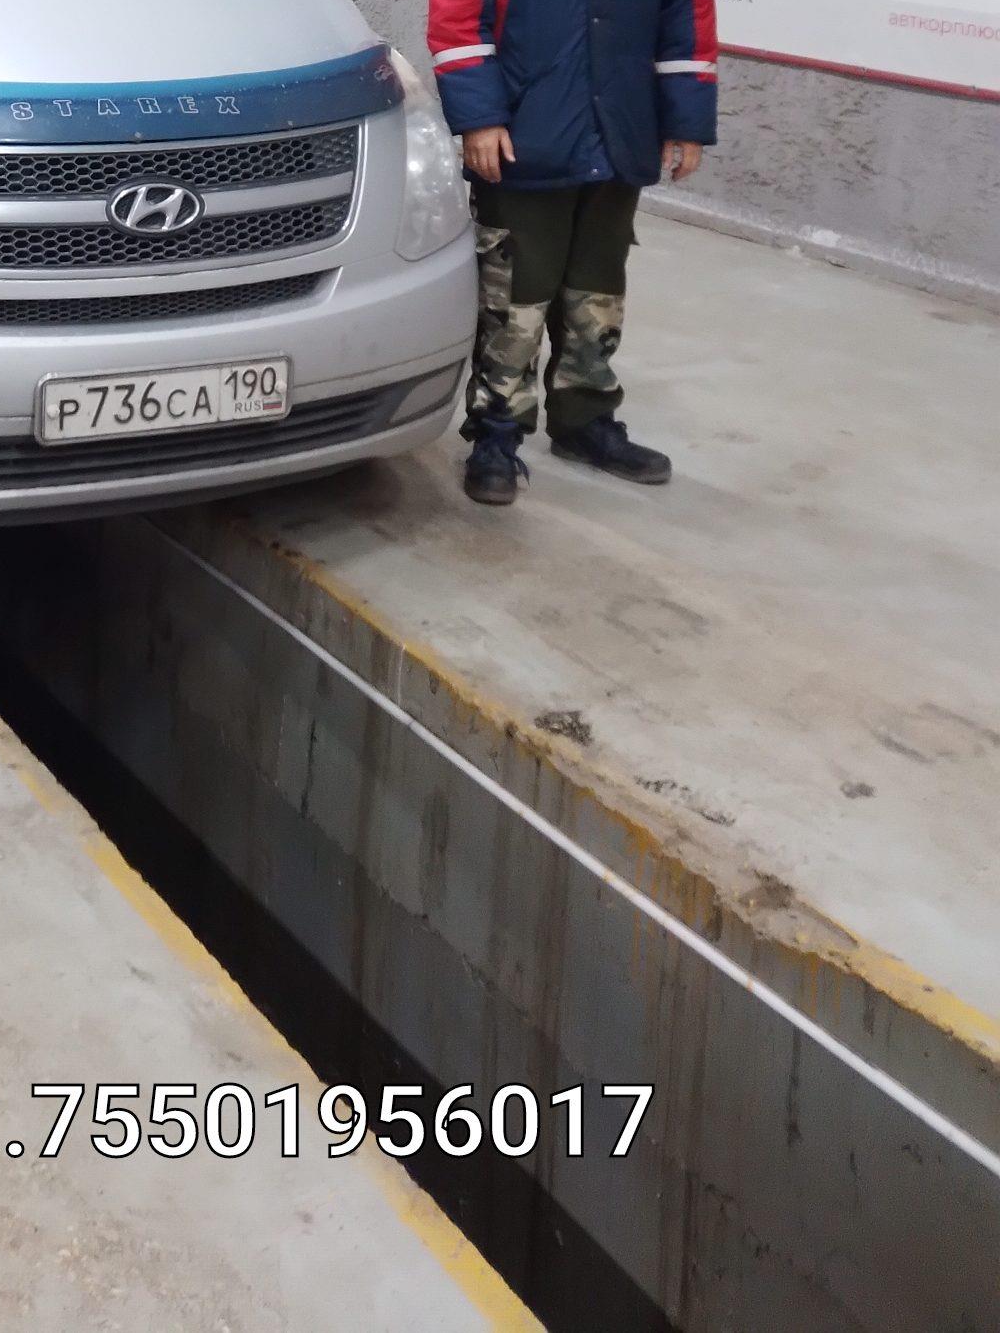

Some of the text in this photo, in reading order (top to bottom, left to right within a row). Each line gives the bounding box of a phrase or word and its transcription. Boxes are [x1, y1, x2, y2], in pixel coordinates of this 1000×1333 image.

[10, 96, 240, 120] STAREX
[225, 366, 277, 401] 190
[234, 401, 262, 414] RUS
